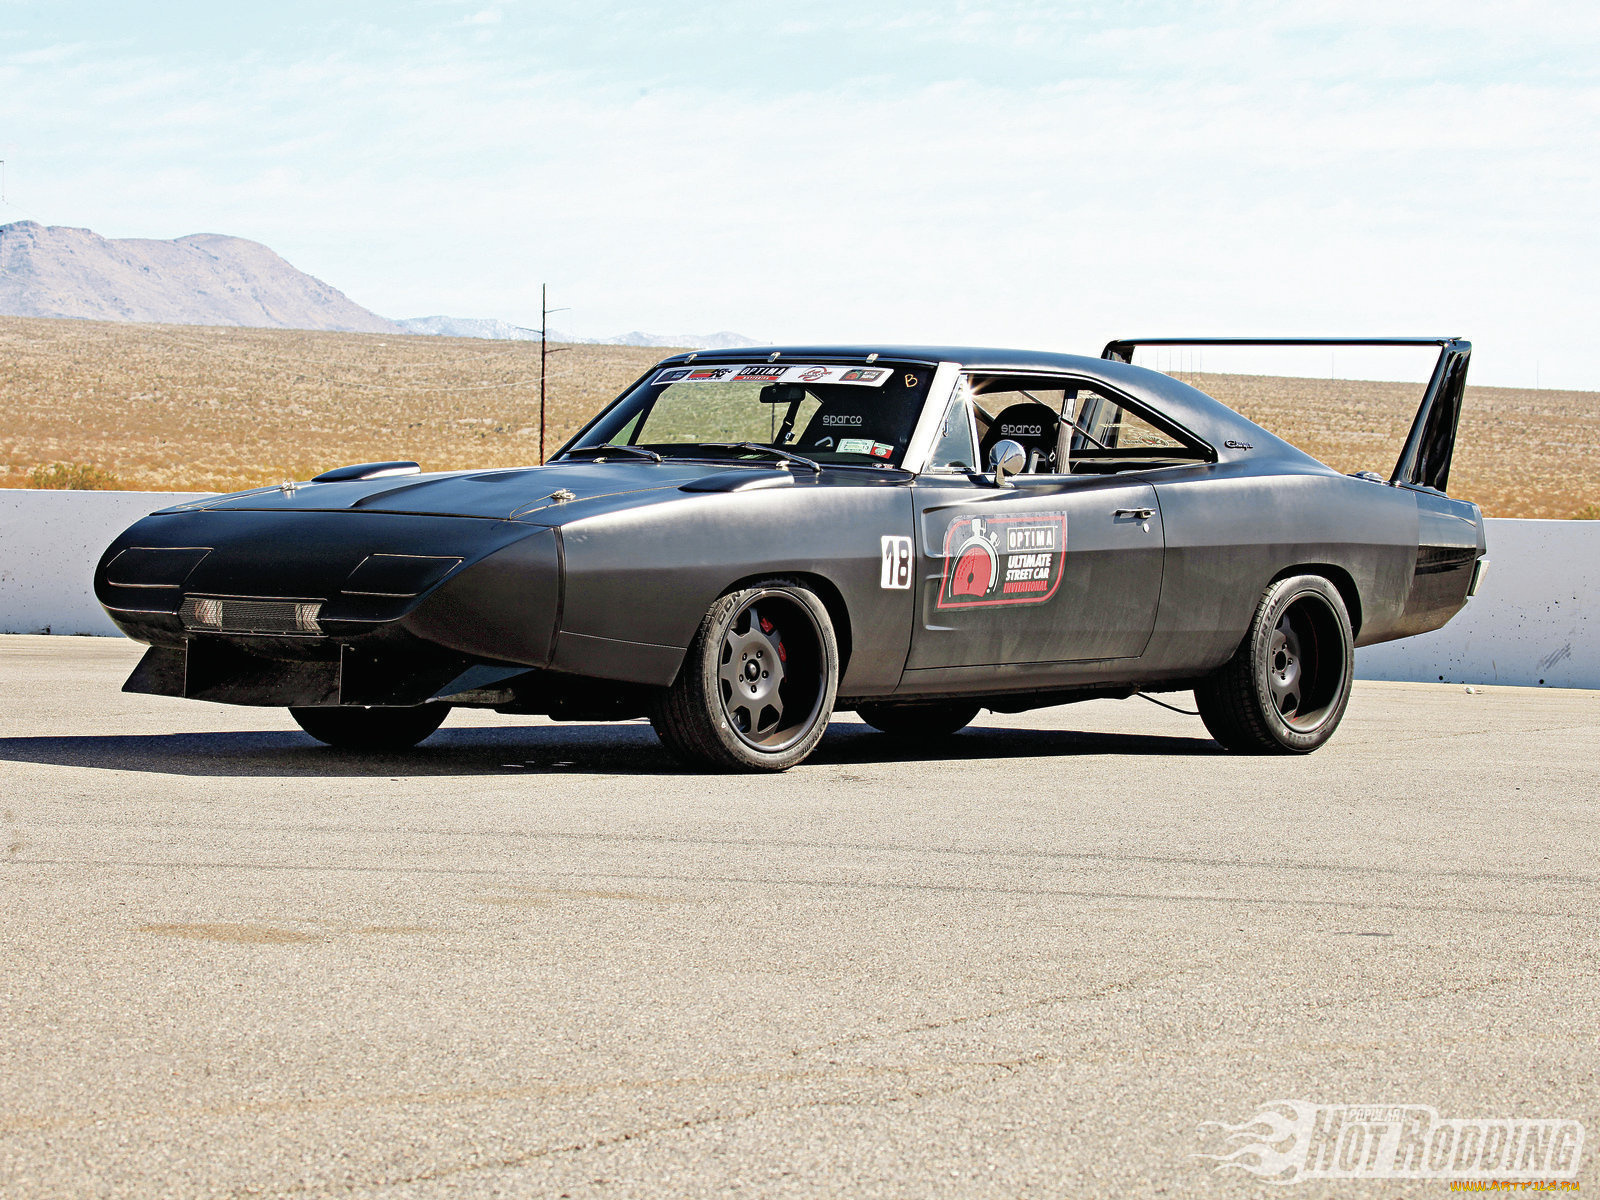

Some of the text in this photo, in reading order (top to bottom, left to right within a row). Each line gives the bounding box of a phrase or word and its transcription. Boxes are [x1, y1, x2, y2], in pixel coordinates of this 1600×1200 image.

[741, 367, 787, 376] OPTIMA
[822, 414, 863, 427] sparco
[1000, 423, 1042, 436] sparco
[1009, 529, 1053, 549] OPTIMA
[885, 539, 910, 586] 18
[1007, 553, 1053, 569] ULTIMATE
[1005, 567, 1050, 581] STREET CAR
[1003, 580, 1048, 594] INVITATIONAL
